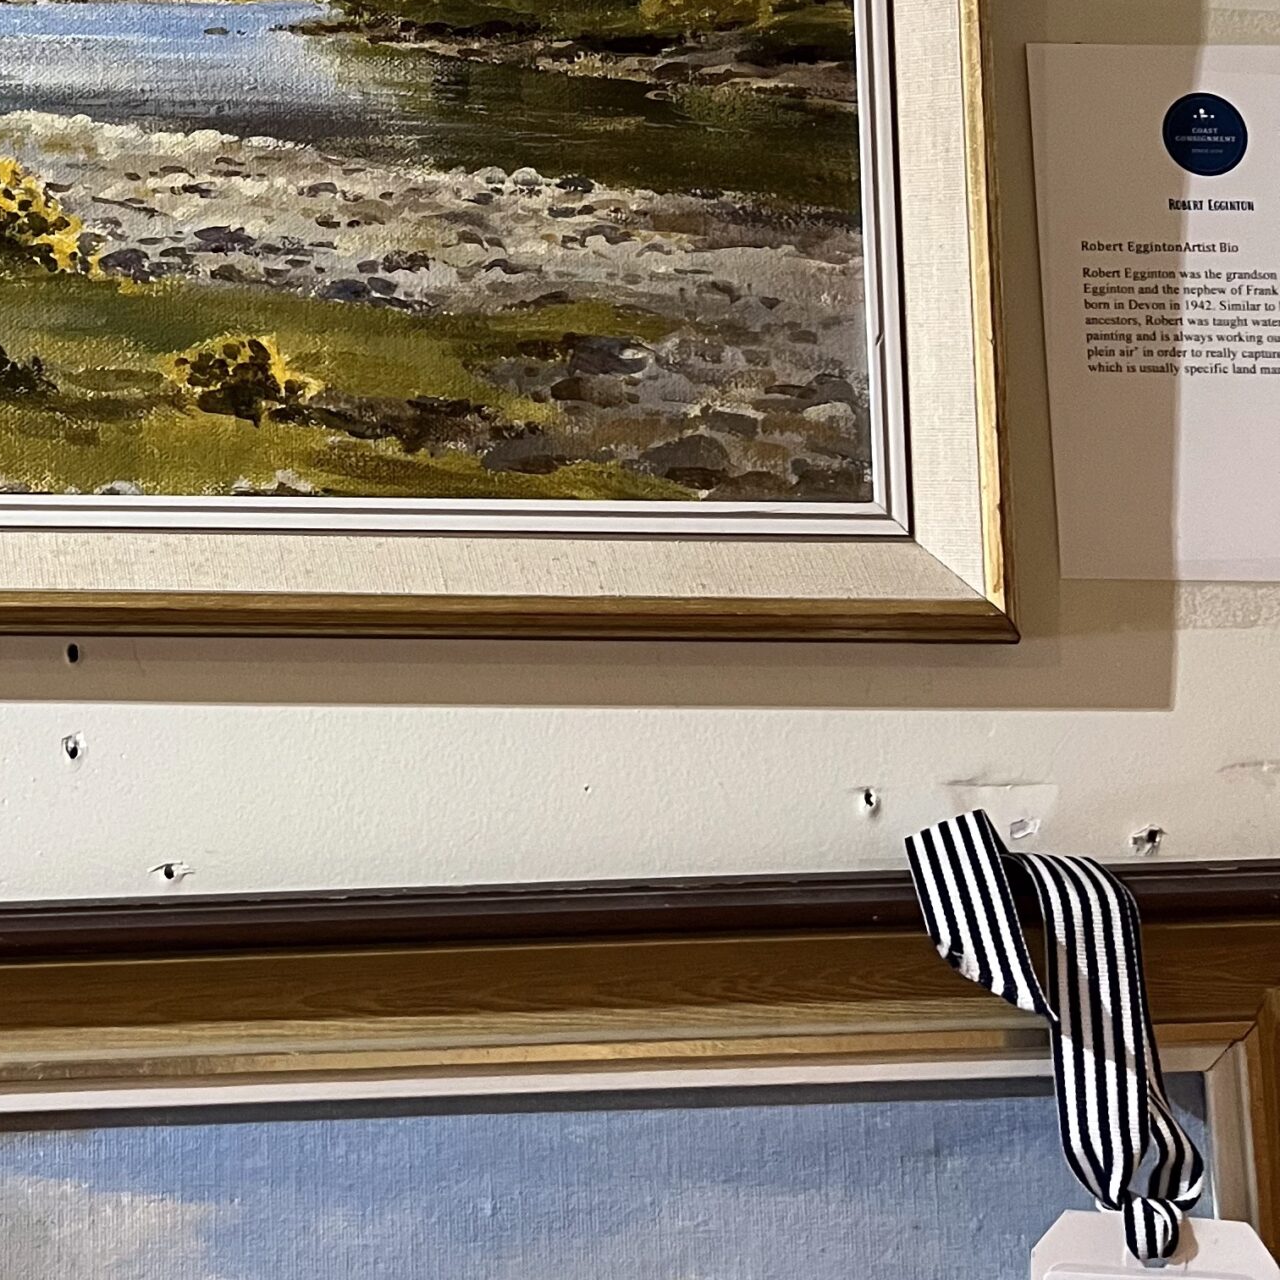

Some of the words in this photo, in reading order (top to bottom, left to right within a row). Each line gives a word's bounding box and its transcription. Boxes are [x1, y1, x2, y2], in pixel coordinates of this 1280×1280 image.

[1168, 198, 1203, 210] ROBERT
[1081, 241, 1123, 252] Robert
[1219, 242, 1239, 253] Bio
[1083, 268, 1120, 278] Robert
[1124, 268, 1175, 281] Egginton
[1180, 271, 1201, 279] was
[1205, 269, 1221, 279] the
[1226, 269, 1277, 282] grandson
[1084, 284, 1134, 295] Egginton
[1138, 285, 1159, 294] and
[1162, 285, 1179, 294] the
[1184, 285, 1225, 297] nephew
[1230, 285, 1244, 295] of
[1246, 285, 1279, 296] Frank
[1084, 300, 1110, 309] born
[1114, 300, 1124, 310] in
[1129, 300, 1166, 310] Devon
[1169, 300, 1180, 310] in
[1219, 301, 1261, 311] Similar
[1265, 303, 1276, 311] to
[1085, 317, 1141, 326] ancestors,
[1145, 315, 1183, 326] Robert
[1187, 318, 1209, 326] was
[1213, 317, 1248, 329] taught
[1086, 331, 1132, 343] painting
[1136, 332, 1156, 341] and
[1160, 332, 1170, 341] is
[1174, 332, 1213, 344] always
[1217, 332, 1263, 345] working
[1087, 347, 1115, 359] plein
[1143, 347, 1154, 357] in
[1157, 347, 1187, 357] order
[1191, 348, 1201, 357] to
[1206, 347, 1237, 360] really
[1088, 362, 1122, 373] which
[1127, 364, 1136, 373] is
[1140, 363, 1179, 376] usually
[1184, 364, 1228, 376] specific
[1232, 364, 1256, 374] land
